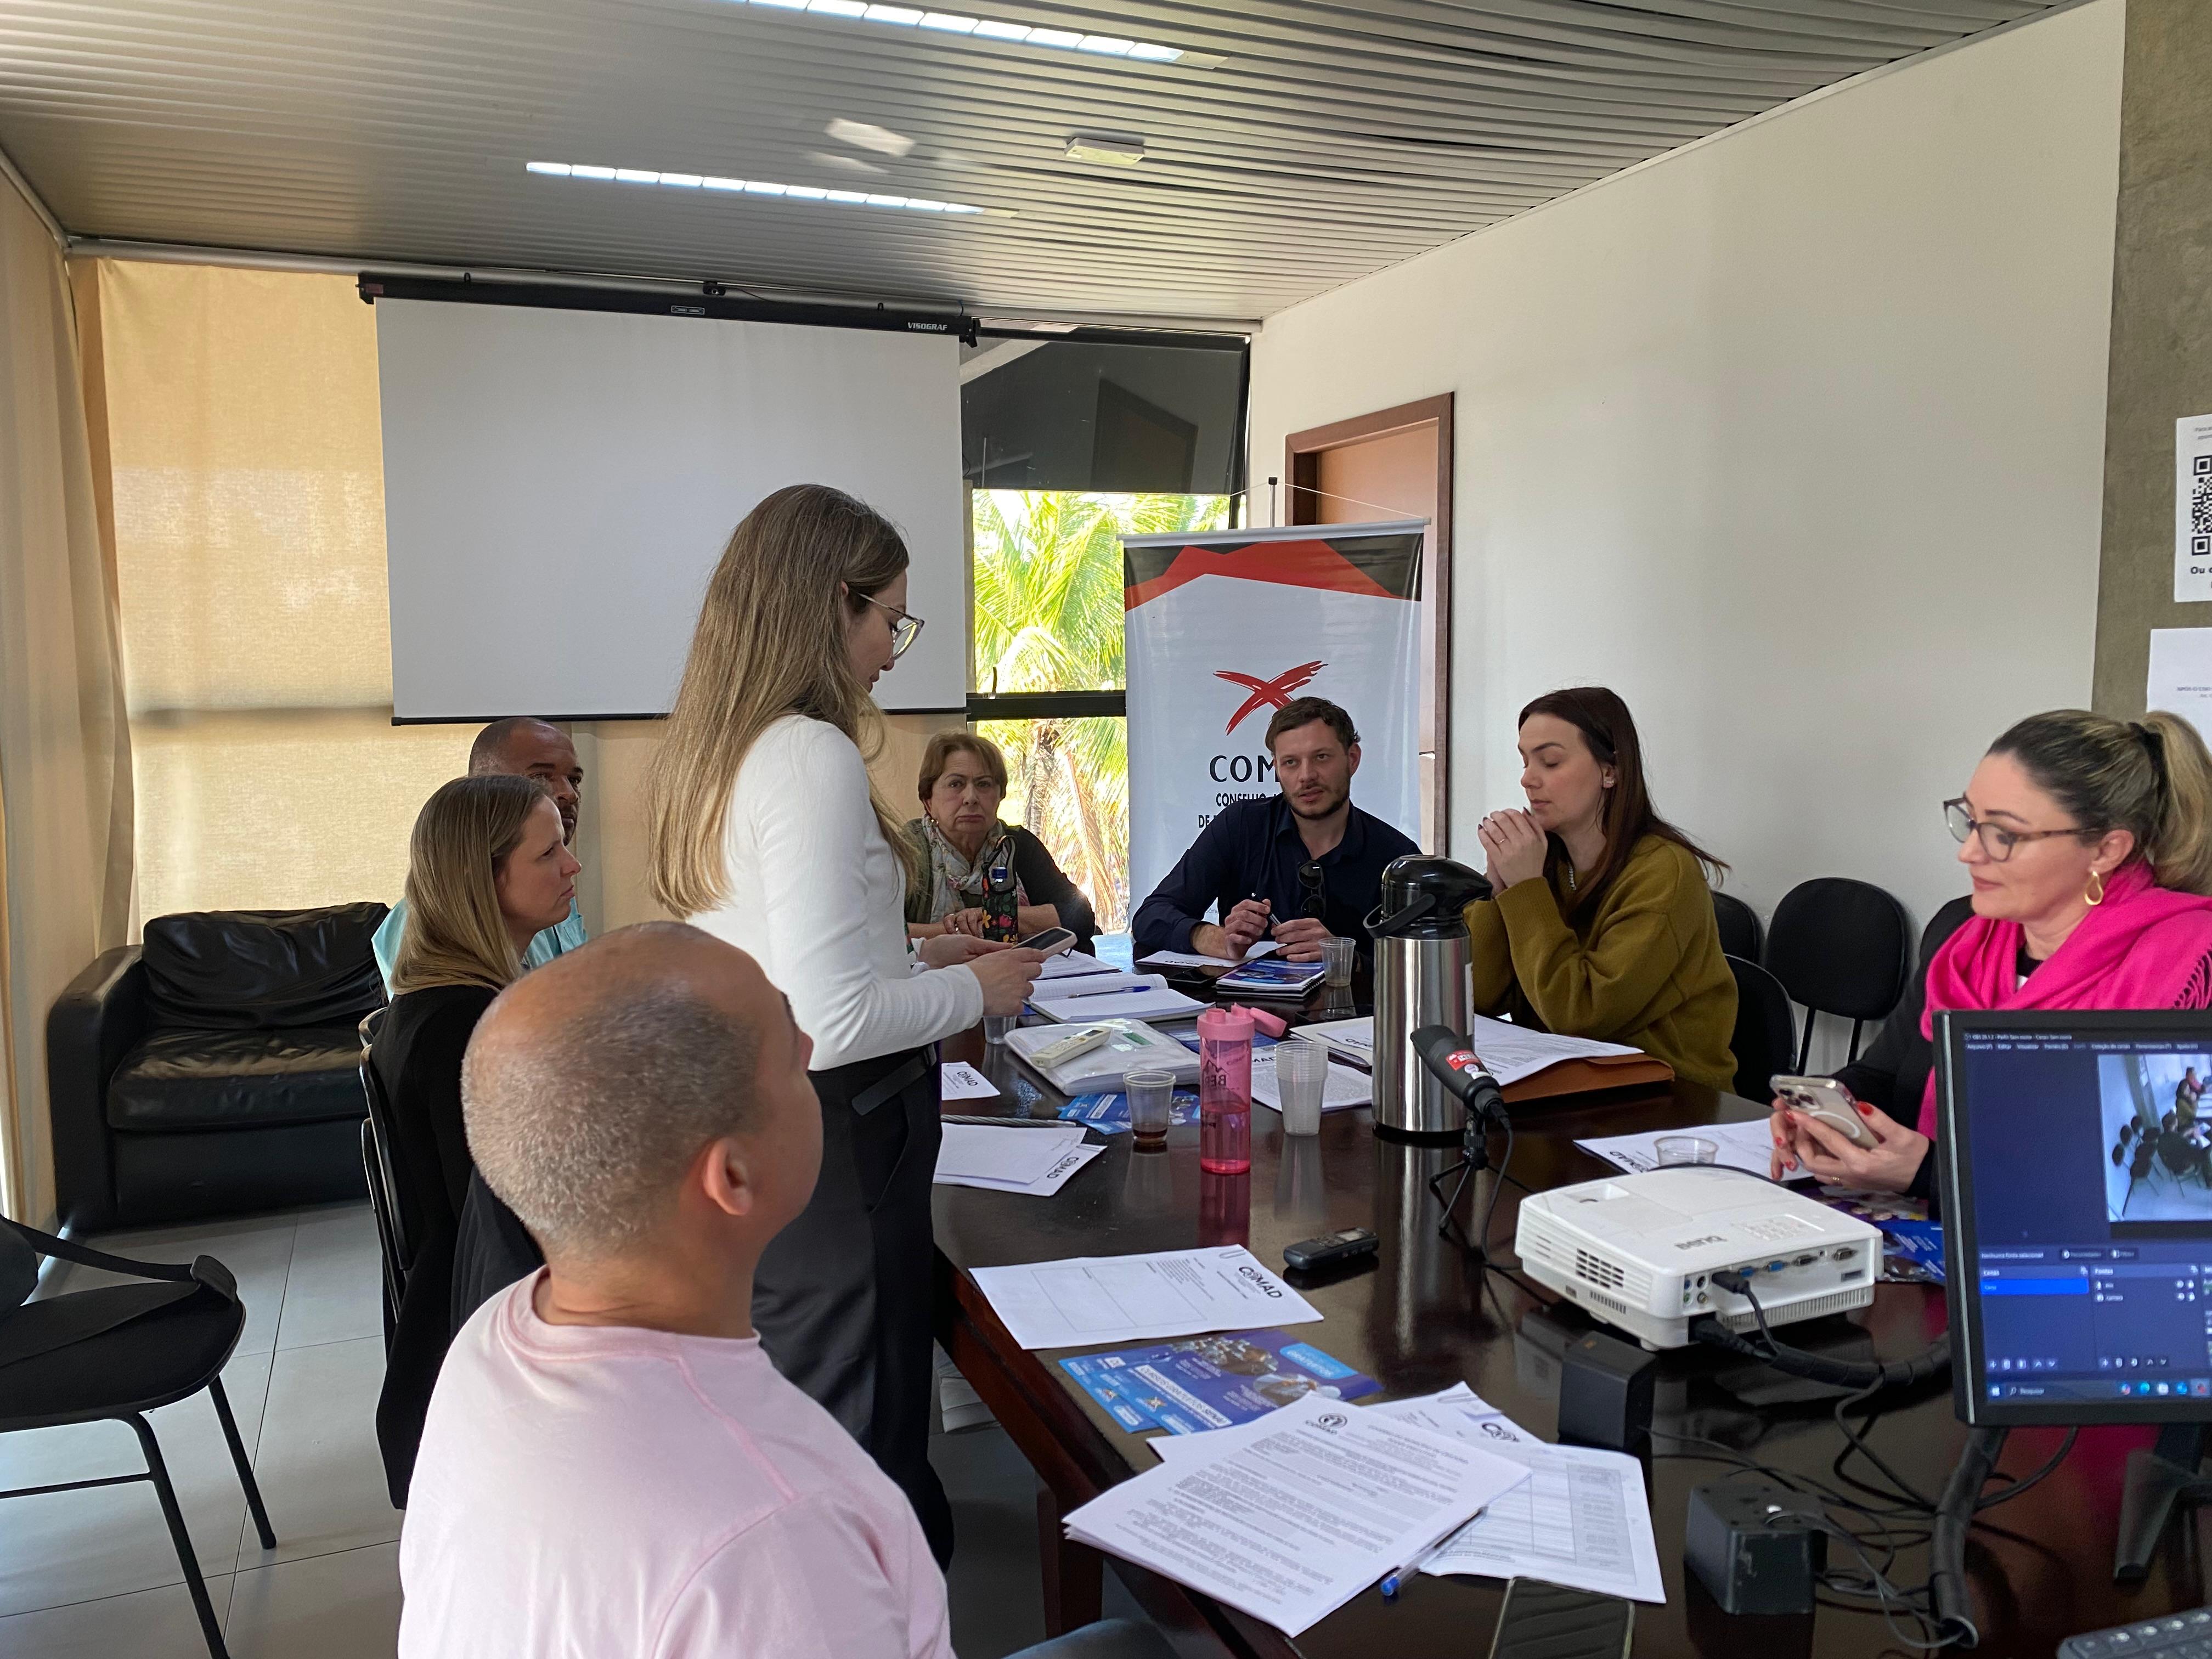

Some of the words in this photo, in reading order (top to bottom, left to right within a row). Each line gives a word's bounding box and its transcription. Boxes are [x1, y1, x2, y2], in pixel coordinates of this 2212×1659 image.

[907, 322, 948, 331] VISOGRAF
[2191, 566, 2205, 574] Ou
[1210, 755, 1280, 783] COM
[1238, 1266, 1283, 1298] COMAD
